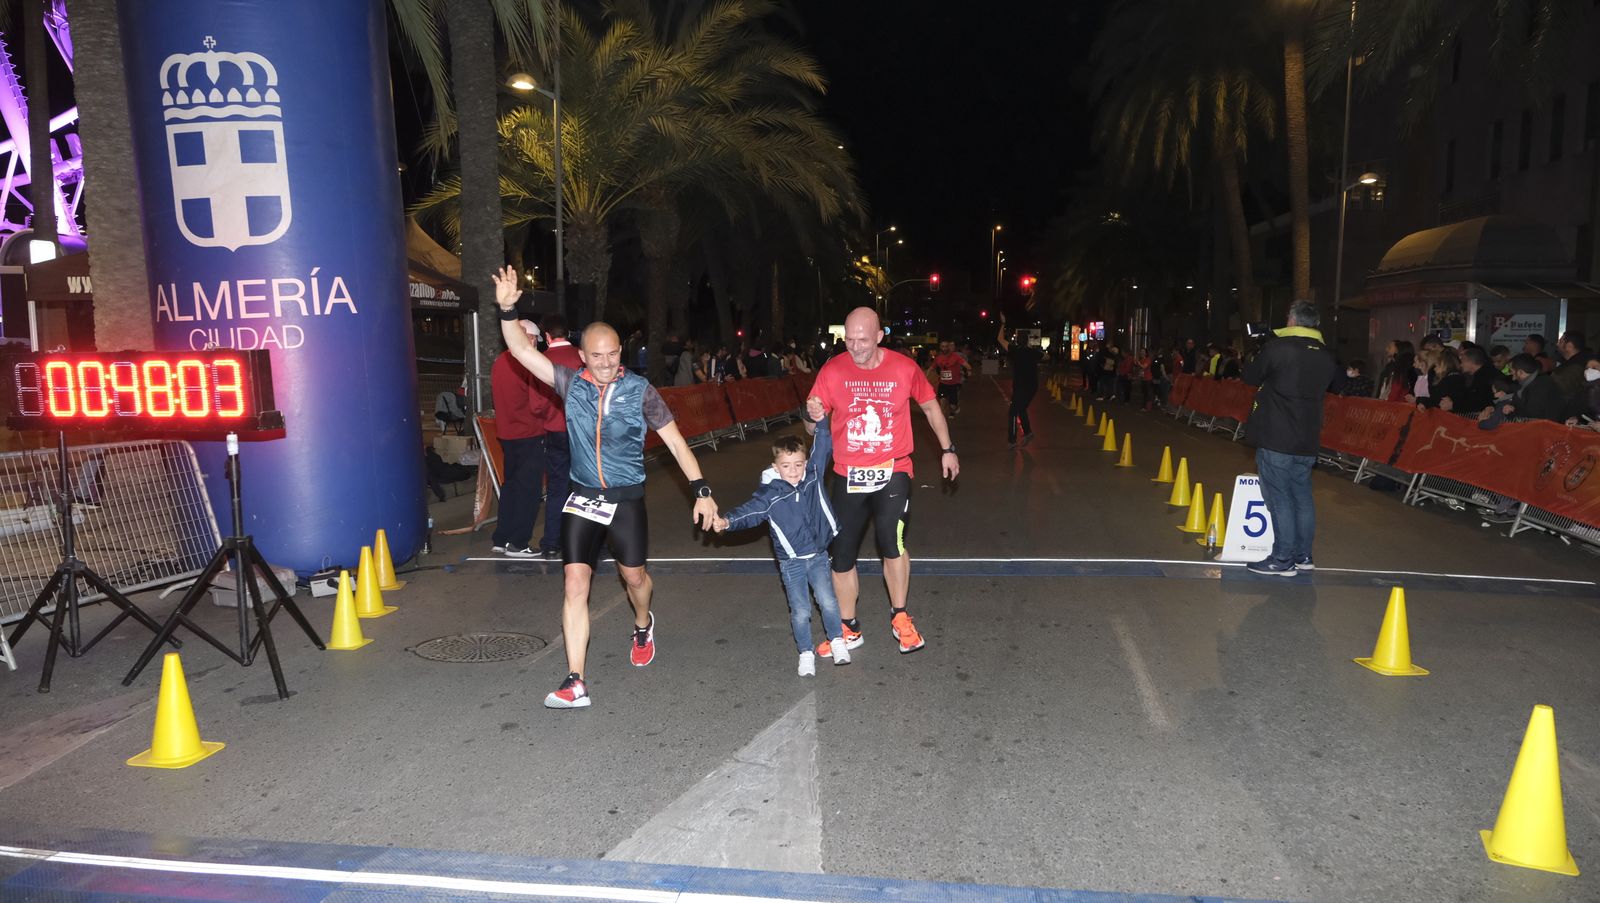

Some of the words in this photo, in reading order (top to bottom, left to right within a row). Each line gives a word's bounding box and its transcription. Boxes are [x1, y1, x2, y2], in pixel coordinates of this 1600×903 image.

[156, 267, 359, 322] ALMERÍA
[1510, 320, 1543, 328] Bufete
[189, 325, 305, 352] CIUDAD
[45, 359, 245, 418] 00:48:03
[857, 469, 885, 481] 393
[582, 498, 602, 509] 24
[1242, 500, 1268, 538] 5
